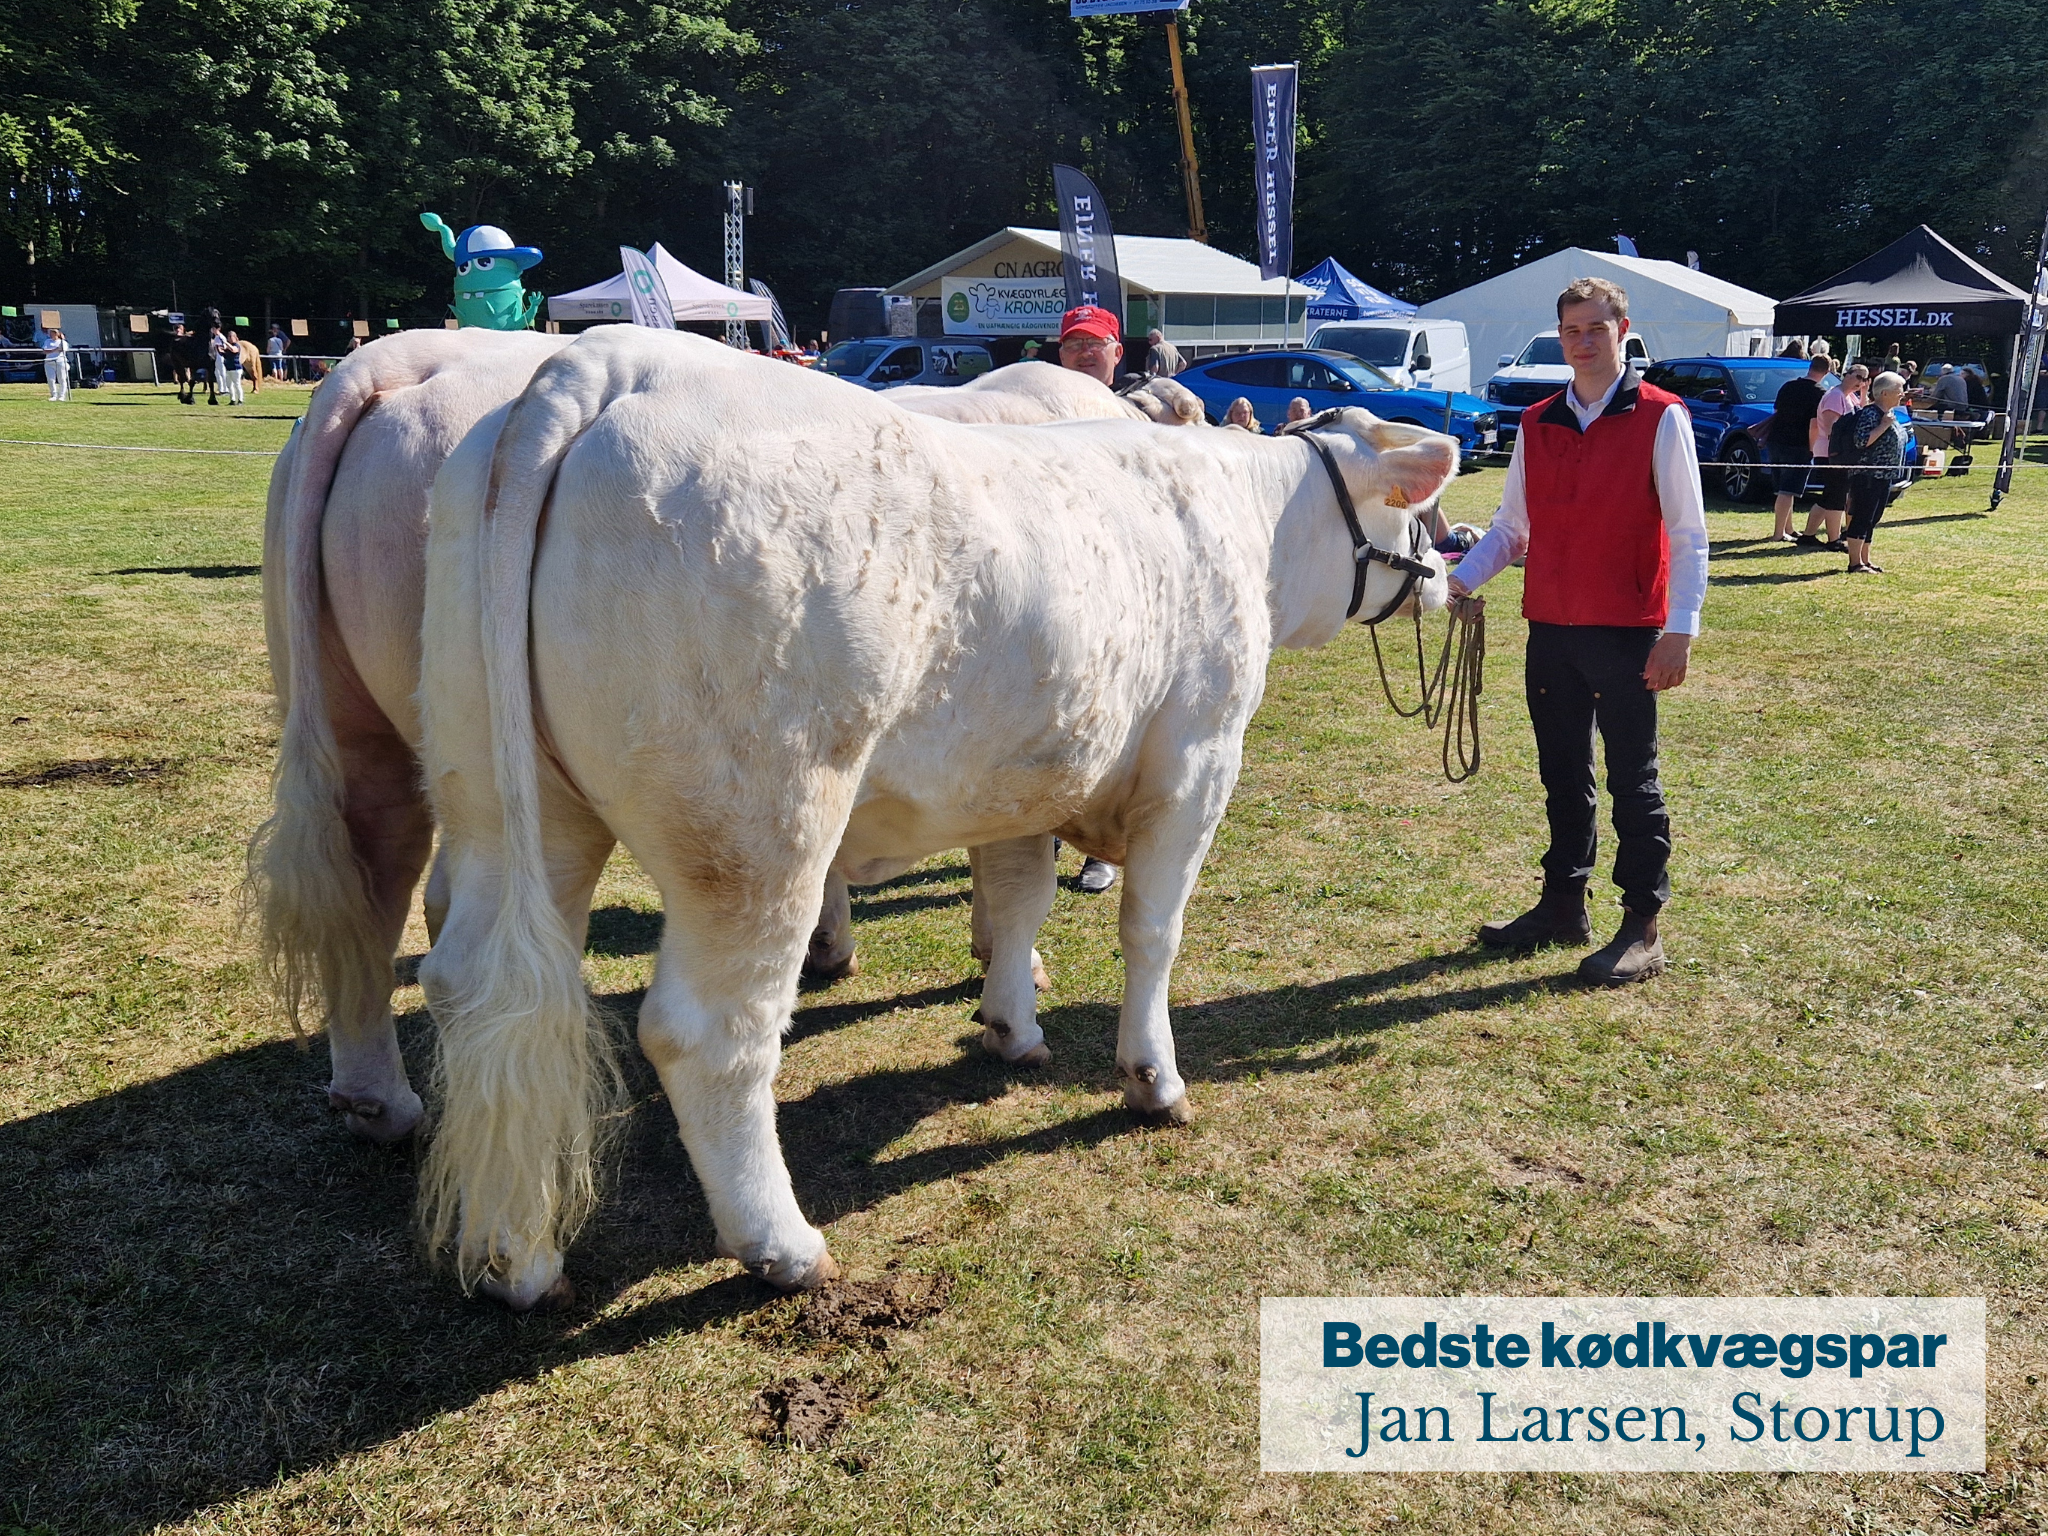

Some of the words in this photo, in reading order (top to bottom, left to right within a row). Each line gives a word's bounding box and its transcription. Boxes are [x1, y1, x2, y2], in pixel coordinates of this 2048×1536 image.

[1266, 83, 1278, 163] EJNER
[1266, 170, 1277, 265] HESSEL
[994, 262, 1017, 278] CN
[998, 289, 1067, 299] KVÆGDYRLÆG
[1004, 300, 1067, 314] KRONBO
[1306, 307, 1349, 317] KRATERNE
[1835, 308, 1954, 327] HESSEL.DK
[1384, 498, 1407, 509] 2206
